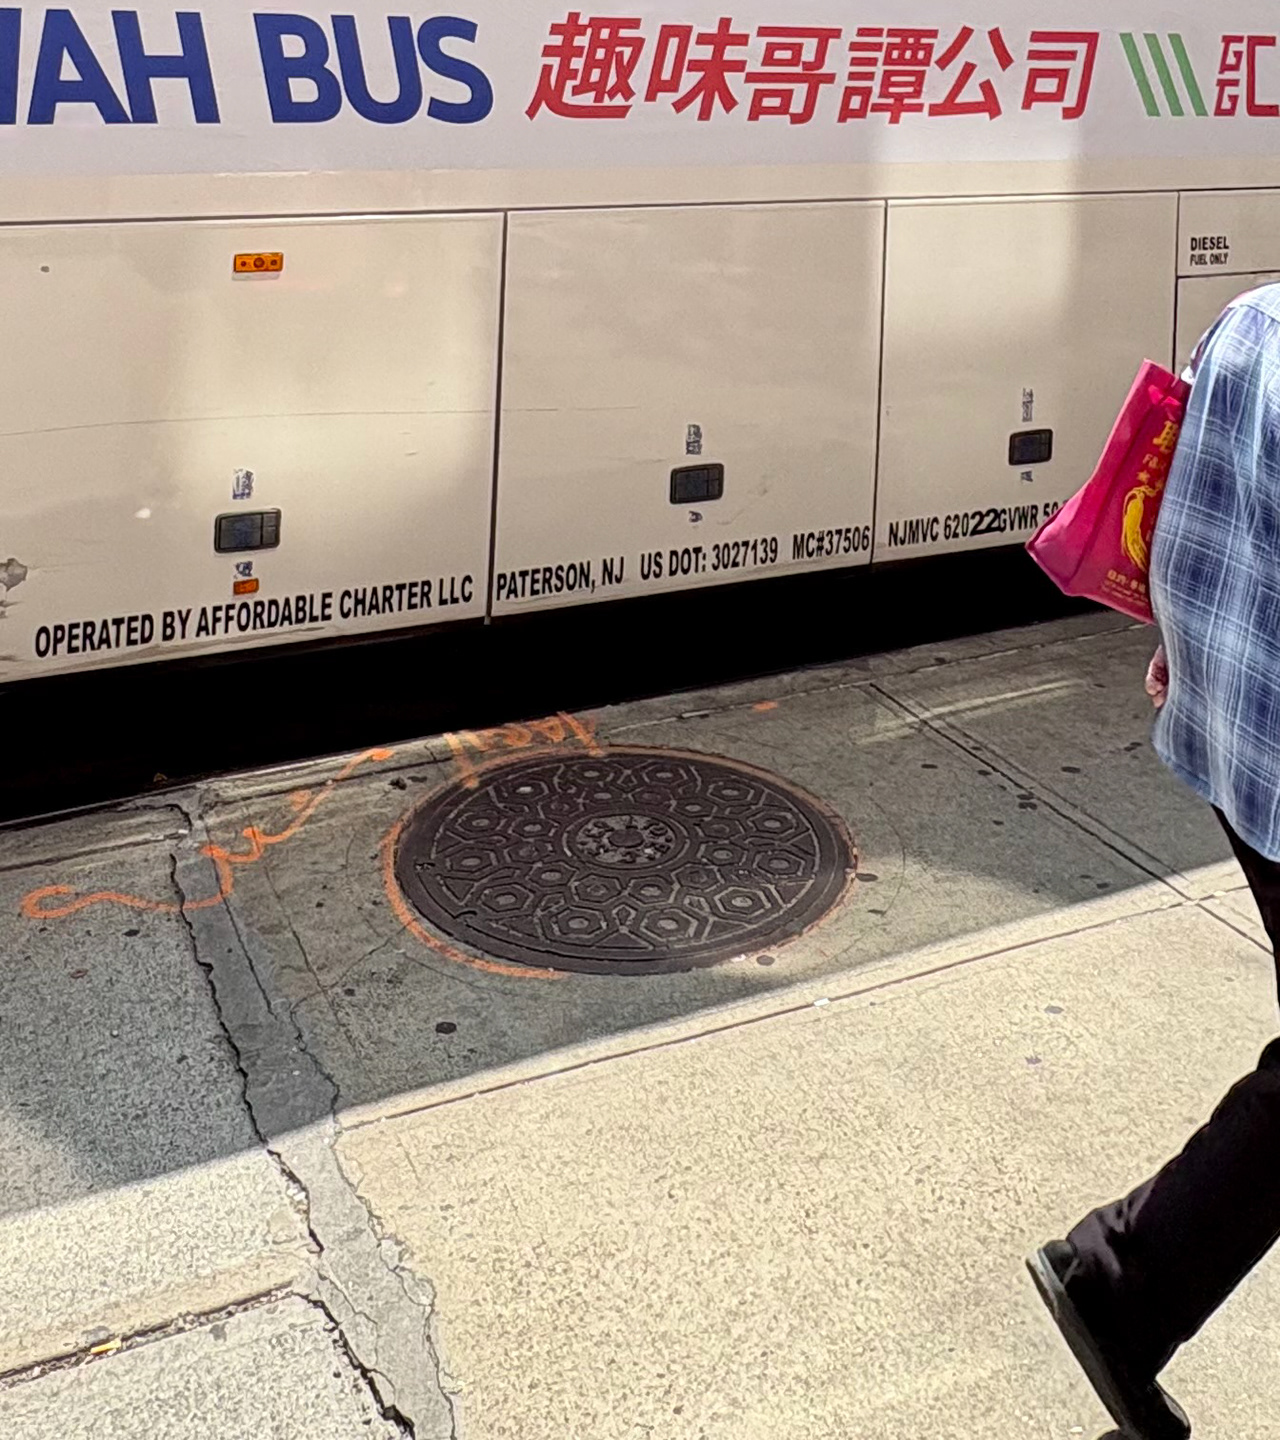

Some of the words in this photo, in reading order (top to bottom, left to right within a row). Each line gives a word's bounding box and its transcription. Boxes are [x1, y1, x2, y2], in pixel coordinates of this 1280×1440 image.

[252, 12, 494, 125] BUS
[524, 11, 1101, 126] 趣味哥譚公司
[1190, 235, 1230, 252] DIESEL
[1190, 253, 1208, 266] FUEL
[1209, 252, 1229, 265] ONLY
[34, 613, 154, 658] OPERATED
[161, 608, 193, 642] BY
[195, 592, 333, 638] AFFORDABLE
[339, 578, 433, 618] CHARTER
[438, 574, 474, 606] LLC
[496, 561, 596, 601] PATERSON,
[601, 556, 625, 585] NJ
[640, 551, 663, 580] US
[668, 546, 706, 576] DOT:
[711, 536, 779, 571] 3027139
[792, 525, 871, 560] MC#37506
[888, 519, 939, 548] NJMVC
